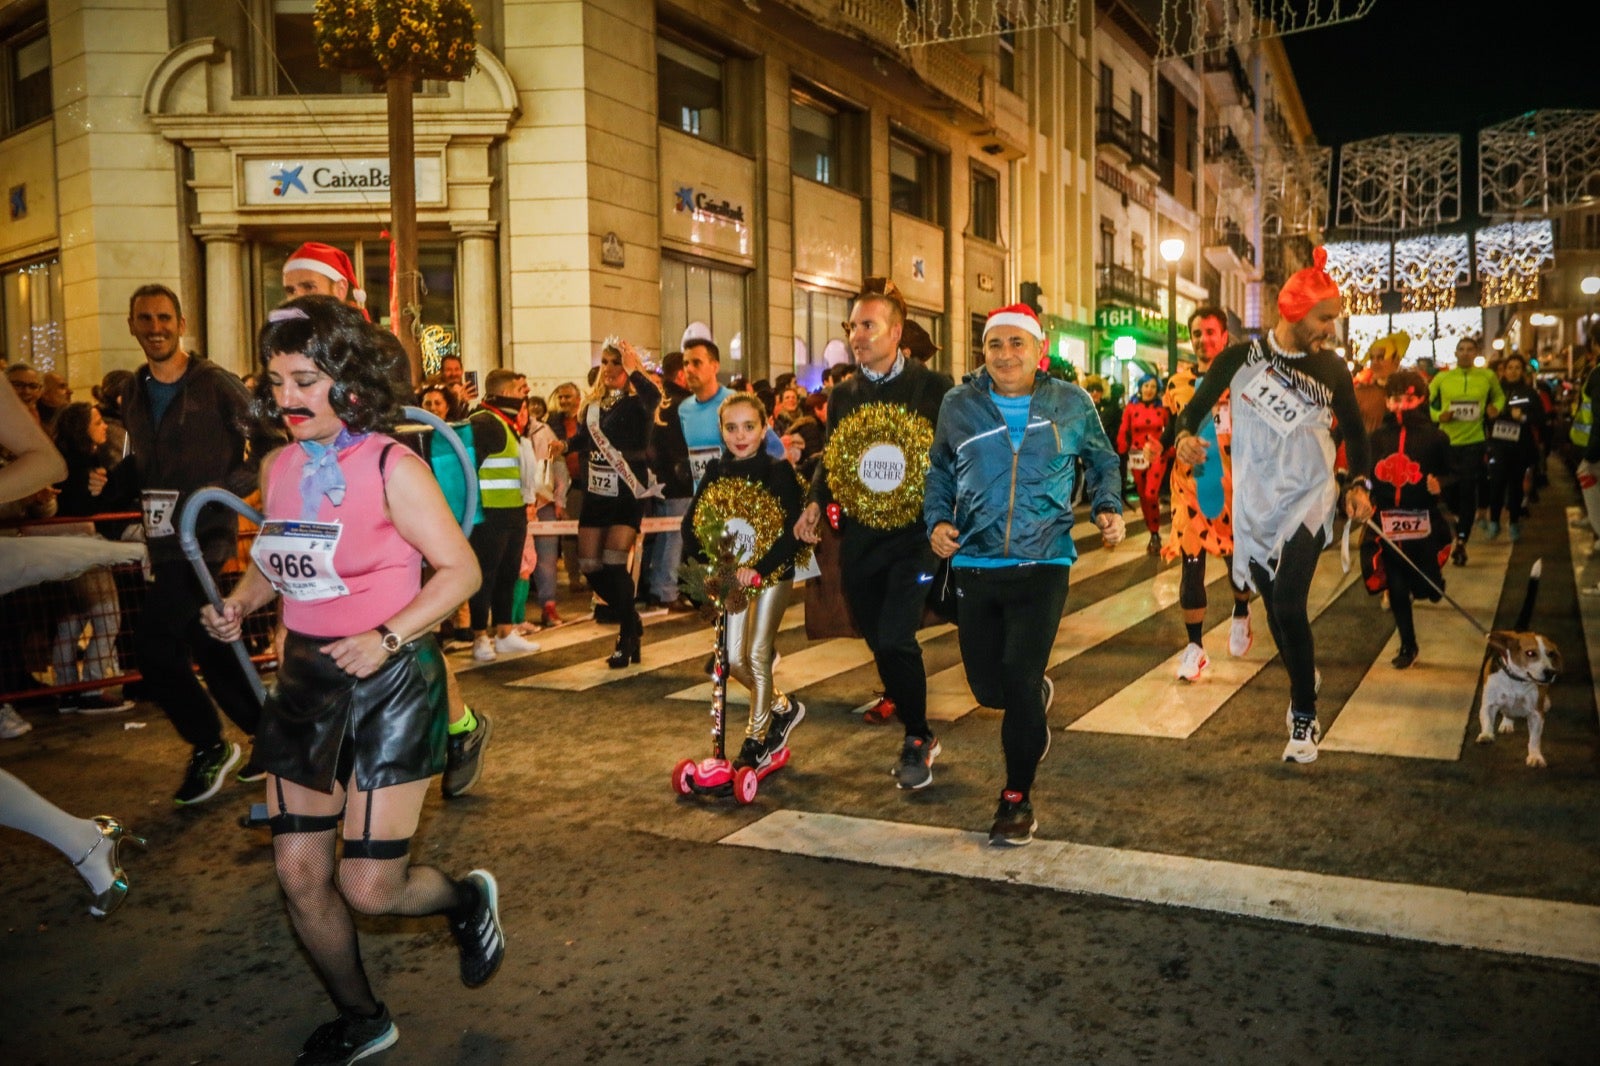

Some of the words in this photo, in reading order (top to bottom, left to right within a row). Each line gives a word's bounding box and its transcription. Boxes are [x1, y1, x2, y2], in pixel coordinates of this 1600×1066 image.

[313, 167, 391, 188] CaixaBa
[1100, 309, 1133, 327] 16H
[1258, 386, 1298, 423] 1120
[863, 460, 904, 471] FERRERO
[863, 469, 902, 480] ROCHER
[592, 476, 611, 489] 572
[1392, 520, 1421, 532] 267
[269, 552, 317, 578] 966
